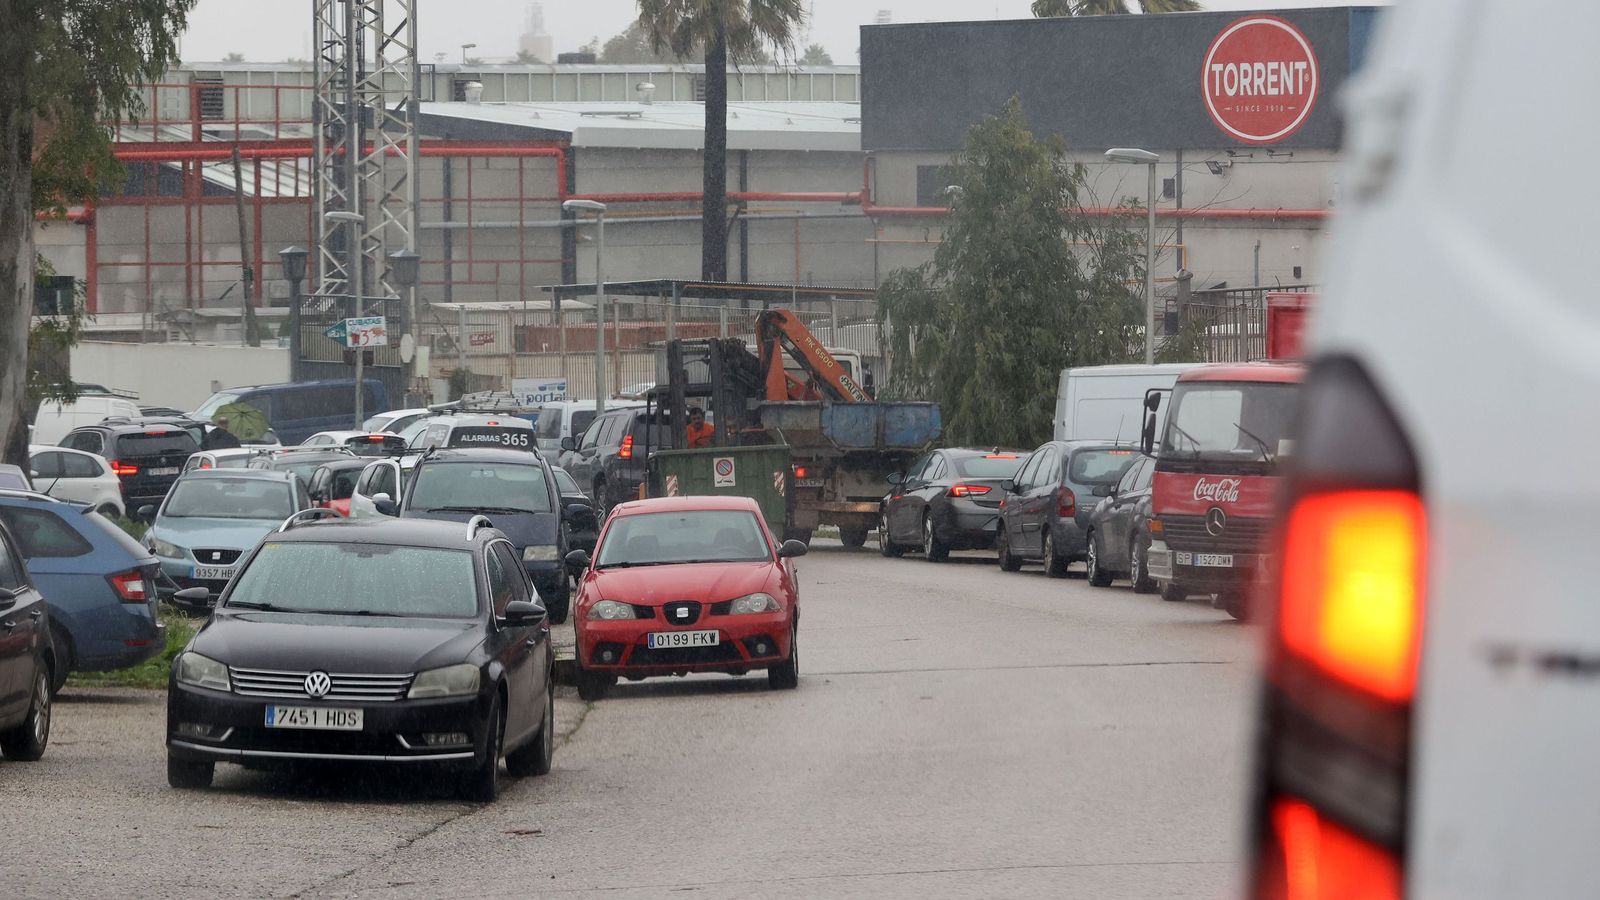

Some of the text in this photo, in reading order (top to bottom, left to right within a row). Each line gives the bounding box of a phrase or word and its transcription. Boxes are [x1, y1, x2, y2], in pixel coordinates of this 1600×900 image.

[1211, 61, 1307, 97] TORRENT
[815, 348, 834, 368] 6500
[461, 432, 529, 446] ALARMAS 365
[1199, 555, 1216, 566] 1527
[195, 568, 236, 578] 9357 HB
[656, 632, 716, 647] 0199 FKW
[278, 709, 357, 727] 7451 HDS
